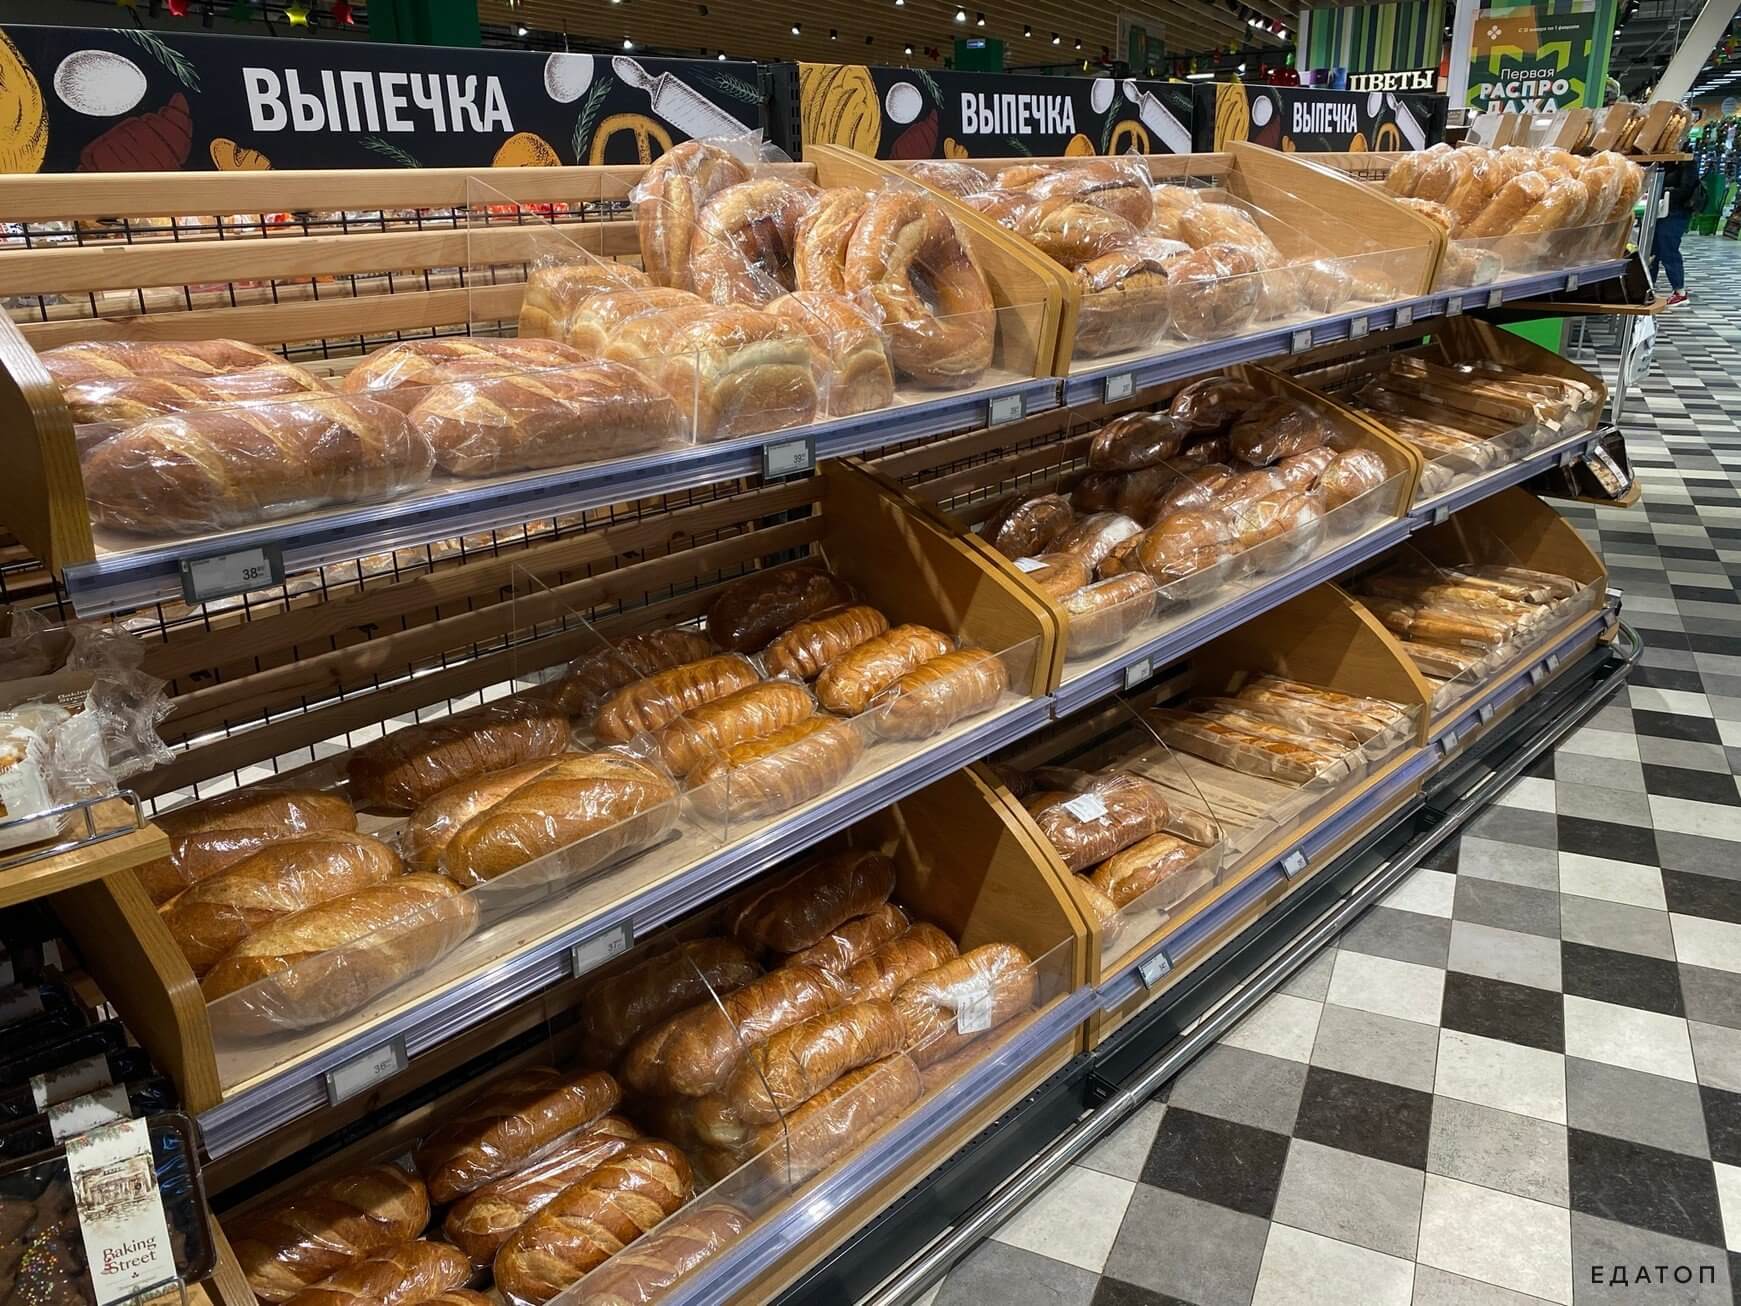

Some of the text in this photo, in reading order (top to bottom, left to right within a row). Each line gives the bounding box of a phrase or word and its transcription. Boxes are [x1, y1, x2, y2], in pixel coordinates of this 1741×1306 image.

[1349, 70, 1434, 92] ЦВЕТЫ
[1501, 68, 1555, 81] Первая
[242, 67, 515, 132] ВЫПЕЧКА
[1479, 78, 1569, 99] РАСПРО
[961, 92, 1076, 134] ВЫПЕЧКА
[1292, 101, 1358, 133] ВЫПЕЧКА
[103, 1236, 157, 1261] Baking
[103, 1251, 157, 1275] Street
